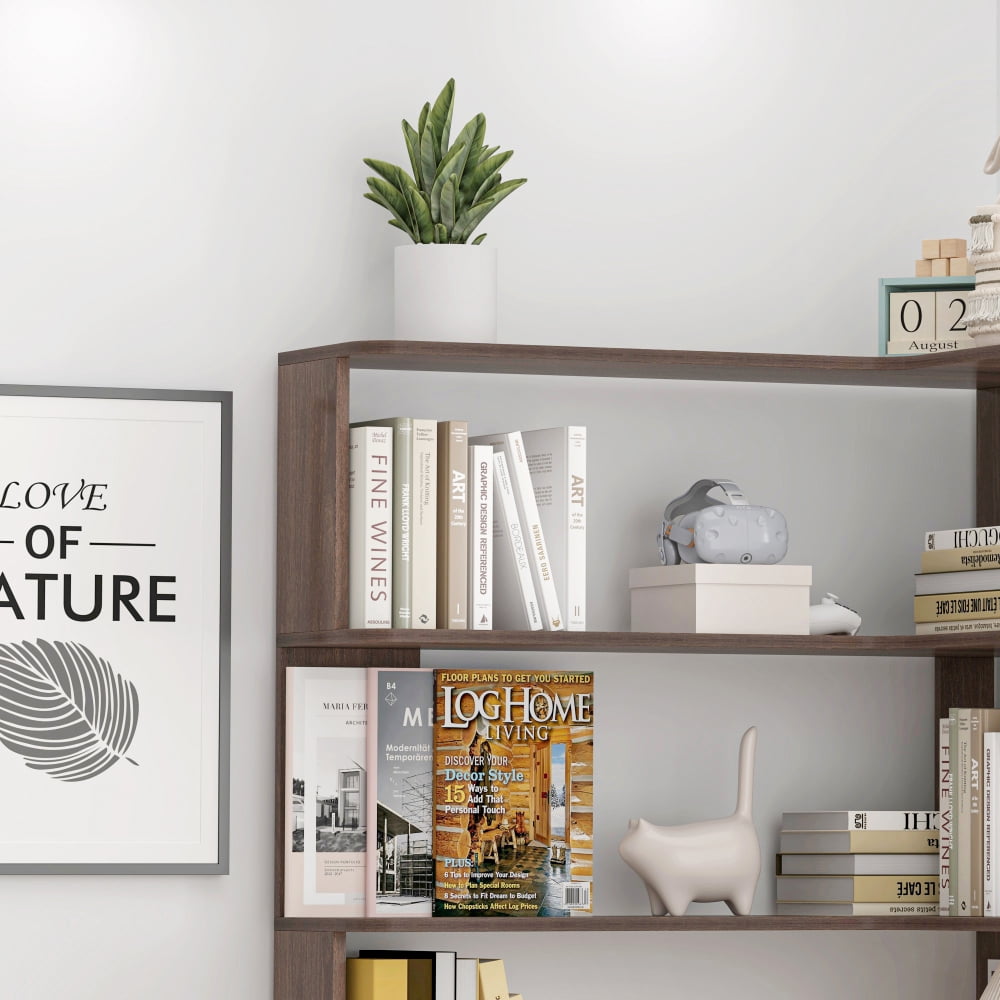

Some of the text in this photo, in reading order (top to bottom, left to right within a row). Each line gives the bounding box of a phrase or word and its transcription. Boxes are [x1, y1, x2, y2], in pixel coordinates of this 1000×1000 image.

[900, 298, 969, 333] 0 2
[908, 340, 960, 353] August
[370, 455, 388, 509] FINE
[0, 478, 108, 511] LOVE
[480, 461, 488, 595] GRAPHIC DESIGN REFERENCED
[25, 524, 82, 560] OF
[370, 520, 388, 602] WINES
[441, 673, 591, 684] FLOOR PLANS TO GET YOU STARTED
[322, 702, 350, 711] MARIA
[485, 725, 549, 741] LIVING
[445, 754, 508, 766] DISCOVER YOUR
[444, 769, 524, 785] Decor Style
[444, 784, 499, 803] 15 Ways to
[467, 795, 504, 804] Add That
[445, 805, 506, 814] Personal Touch
[896, 882, 936, 899] LE CAFÉ
[508, 903, 519, 911] Log
